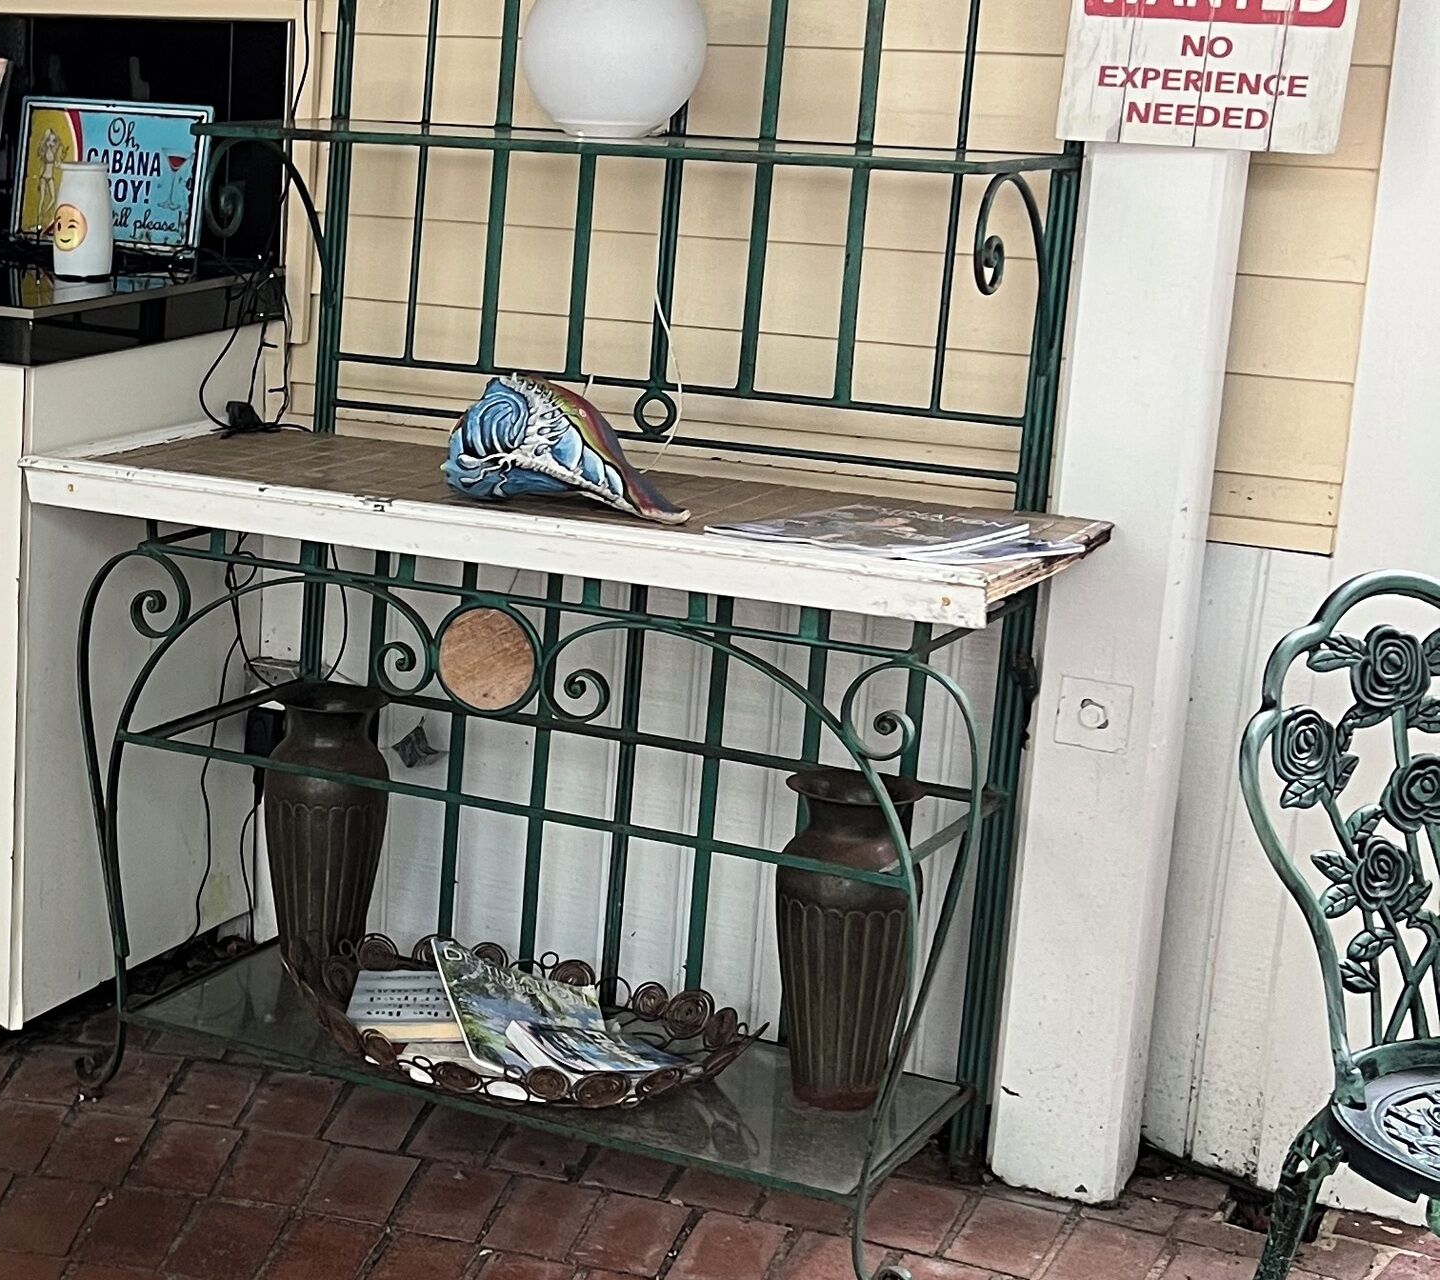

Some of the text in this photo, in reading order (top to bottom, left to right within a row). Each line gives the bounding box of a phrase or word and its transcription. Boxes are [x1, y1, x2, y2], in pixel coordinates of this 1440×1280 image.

[1181, 34, 1233, 60] NO
[1097, 66, 1310, 99] EXPERIENCE
[1125, 101, 1272, 131] NEEDED
[107, 116, 141, 152] Oh,
[87, 147, 161, 178] CABANA
[109, 178, 153, 204] OY!
